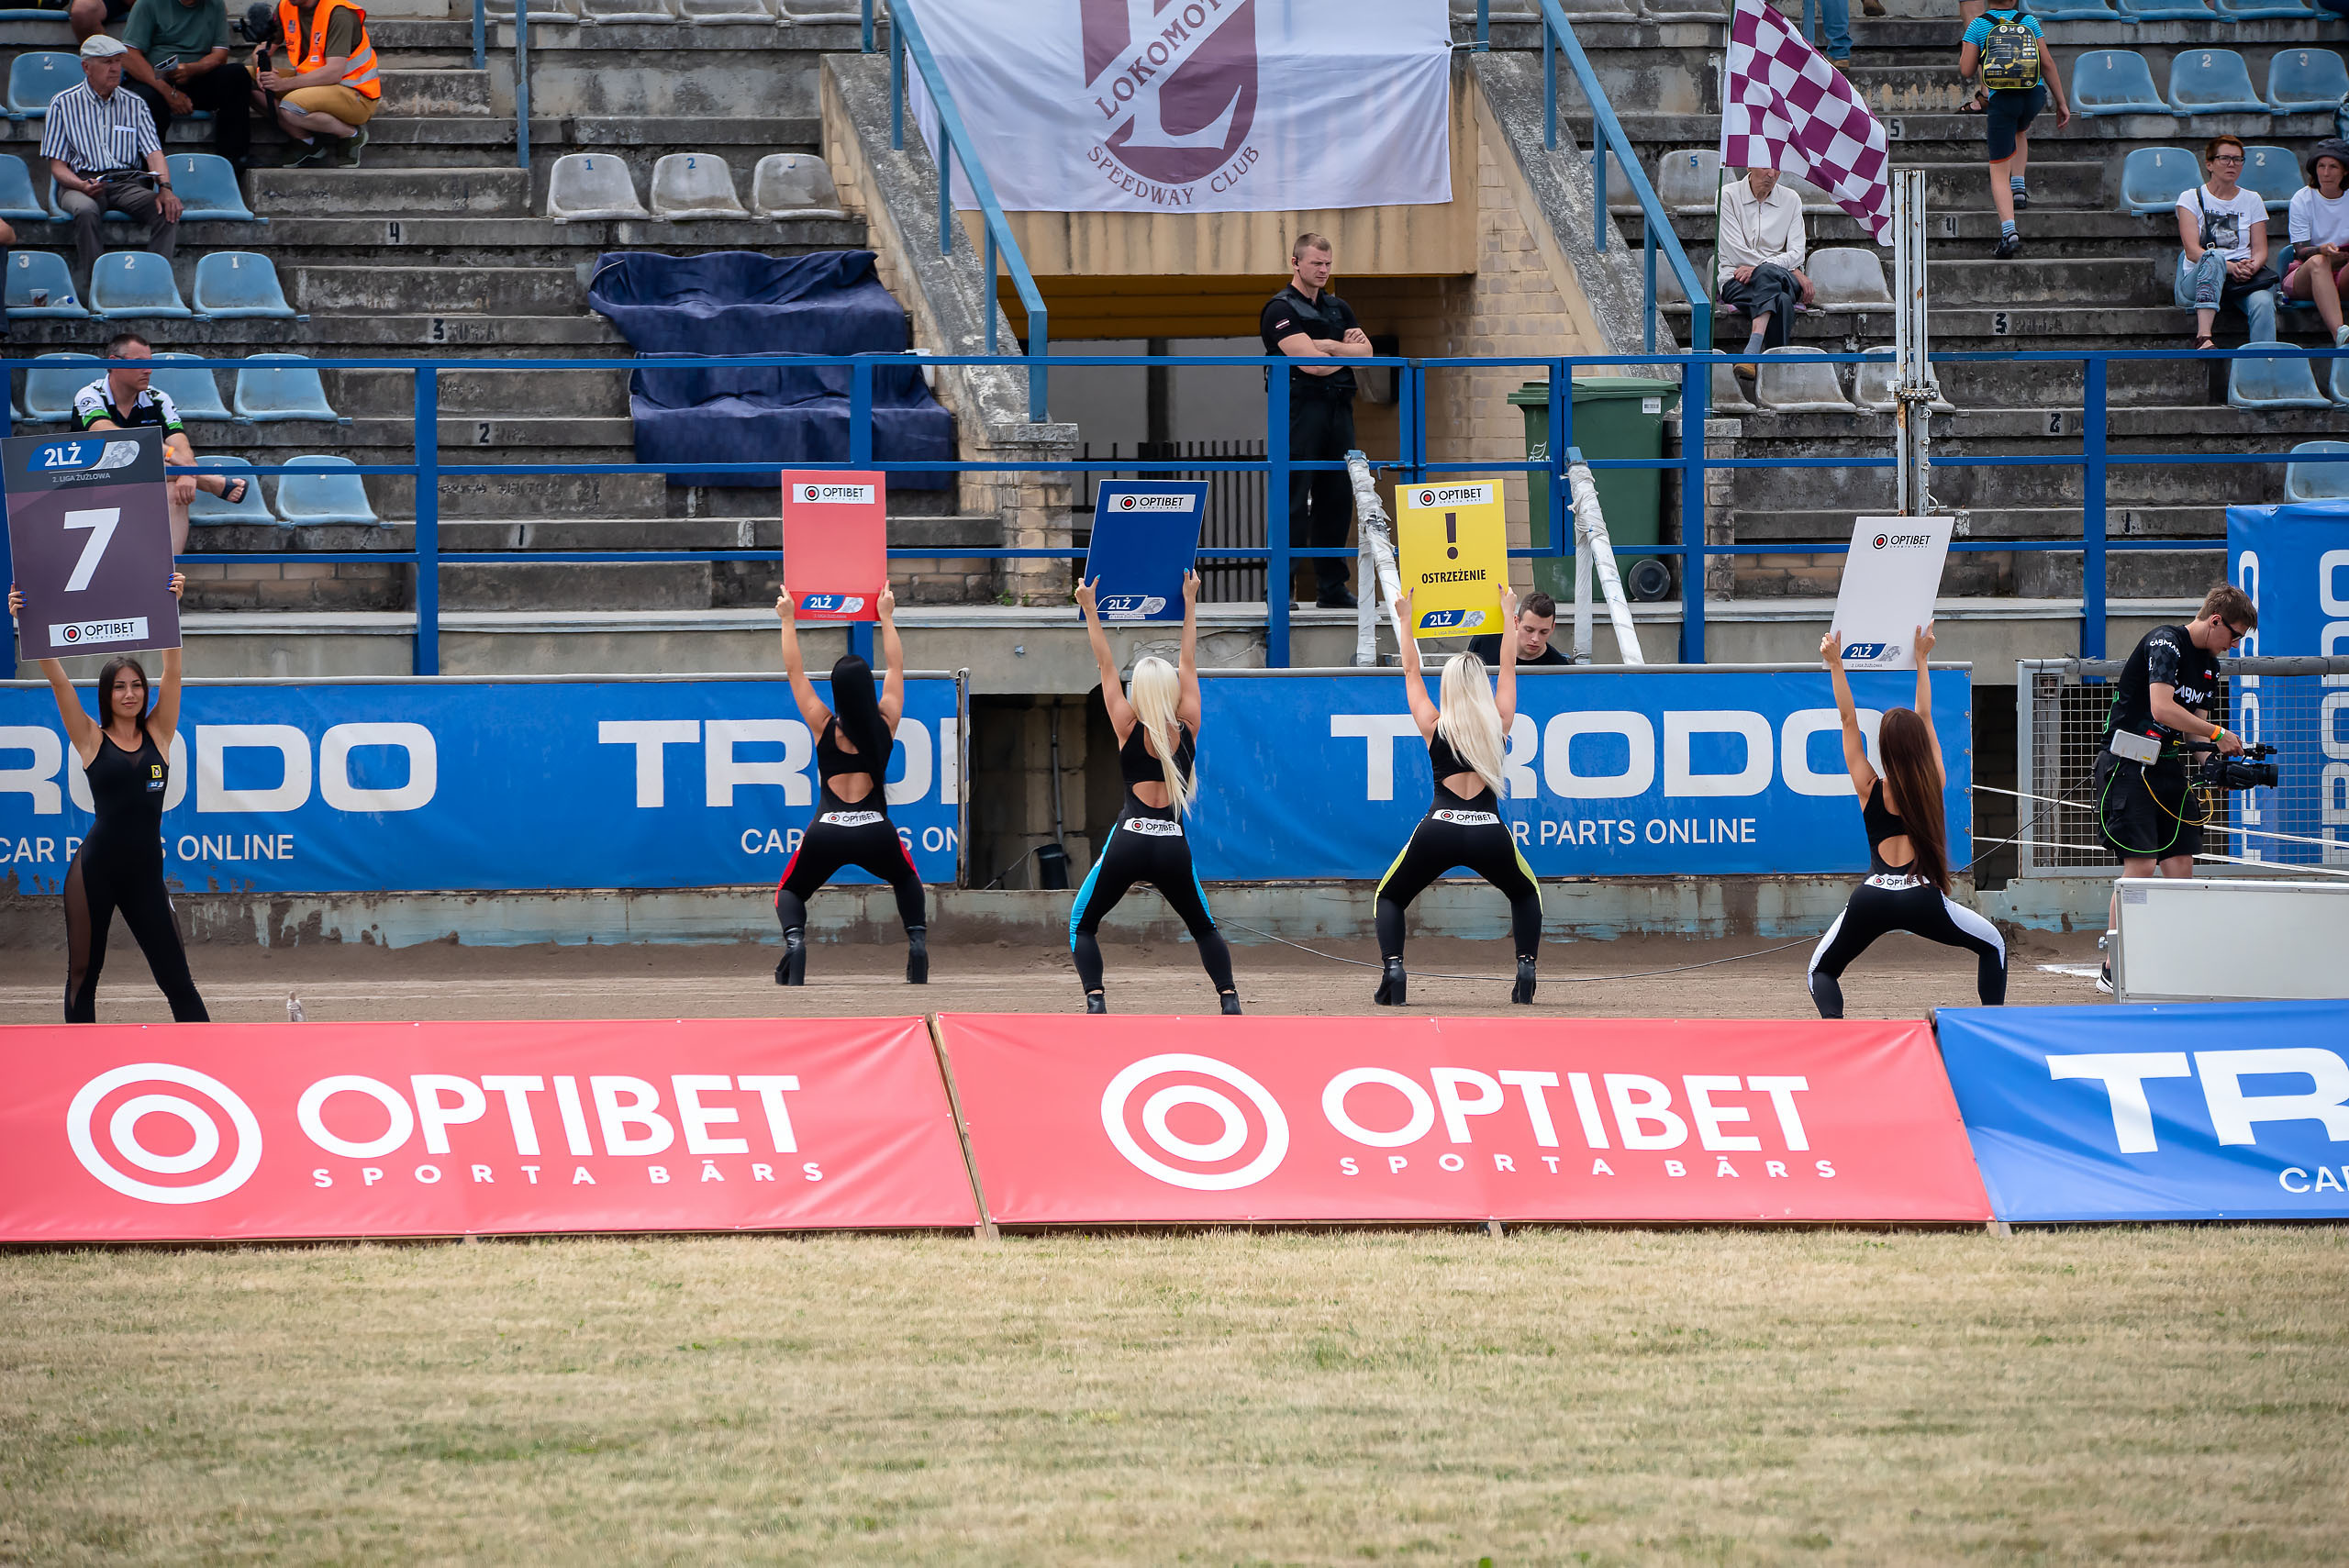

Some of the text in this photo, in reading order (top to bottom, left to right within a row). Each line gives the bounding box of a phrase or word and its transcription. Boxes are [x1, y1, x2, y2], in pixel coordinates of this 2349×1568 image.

[44, 56, 53, 70] 2
[2202, 54, 2211, 68] 2
[2299, 52, 2309, 67] 3
[1890, 118, 1900, 138] 5
[188, 158, 195, 172] 1
[584, 159, 594, 171] 1
[686, 157, 696, 170] 2
[1690, 156, 1698, 167] 5
[2255, 152, 2266, 166] 2
[1087, 146, 1260, 206] SPEEDWAY CLUB
[389, 222, 400, 243] 4
[18, 254, 29, 268] 3
[124, 255, 135, 270] 2
[232, 256, 239, 269] 1
[433, 318, 444, 339] 3
[1996, 313, 2007, 334] 3
[2050, 413, 2061, 433] 2
[479, 423, 490, 443] 2
[43, 442, 83, 467] 2LŻ
[76, 473, 110, 482] ŻUŻLOWA
[823, 487, 864, 498] OPTIBET
[1439, 488, 1482, 500] OPTIBET
[1140, 496, 1184, 506] OPTIBET
[1890, 535, 1932, 545] OPTIBET
[63, 507, 121, 592] 7
[1422, 569, 1486, 584] OSTRZEŻENIE
[810, 595, 832, 608] 2LŻ
[1108, 597, 1131, 610] 2LŻ
[1430, 611, 1453, 626] 2LŻ
[85, 622, 134, 636] OPTIBET
[1850, 644, 1874, 658] 2LŻ
[842, 812, 875, 822] OPTIBET
[1456, 814, 1491, 822] OPTIBET
[1145, 822, 1176, 831] OPTIBET
[1540, 819, 1635, 846] PARTS
[1645, 818, 1756, 844] ONLINE
[177, 834, 295, 862] ONLINE
[1320, 1066, 1811, 1151] OPTIBET
[296, 1073, 801, 1159] OPTIBET
[1339, 1152, 1836, 1179] SPORTA BĀRS
[311, 1159, 824, 1189] SPORTA BĀRS
